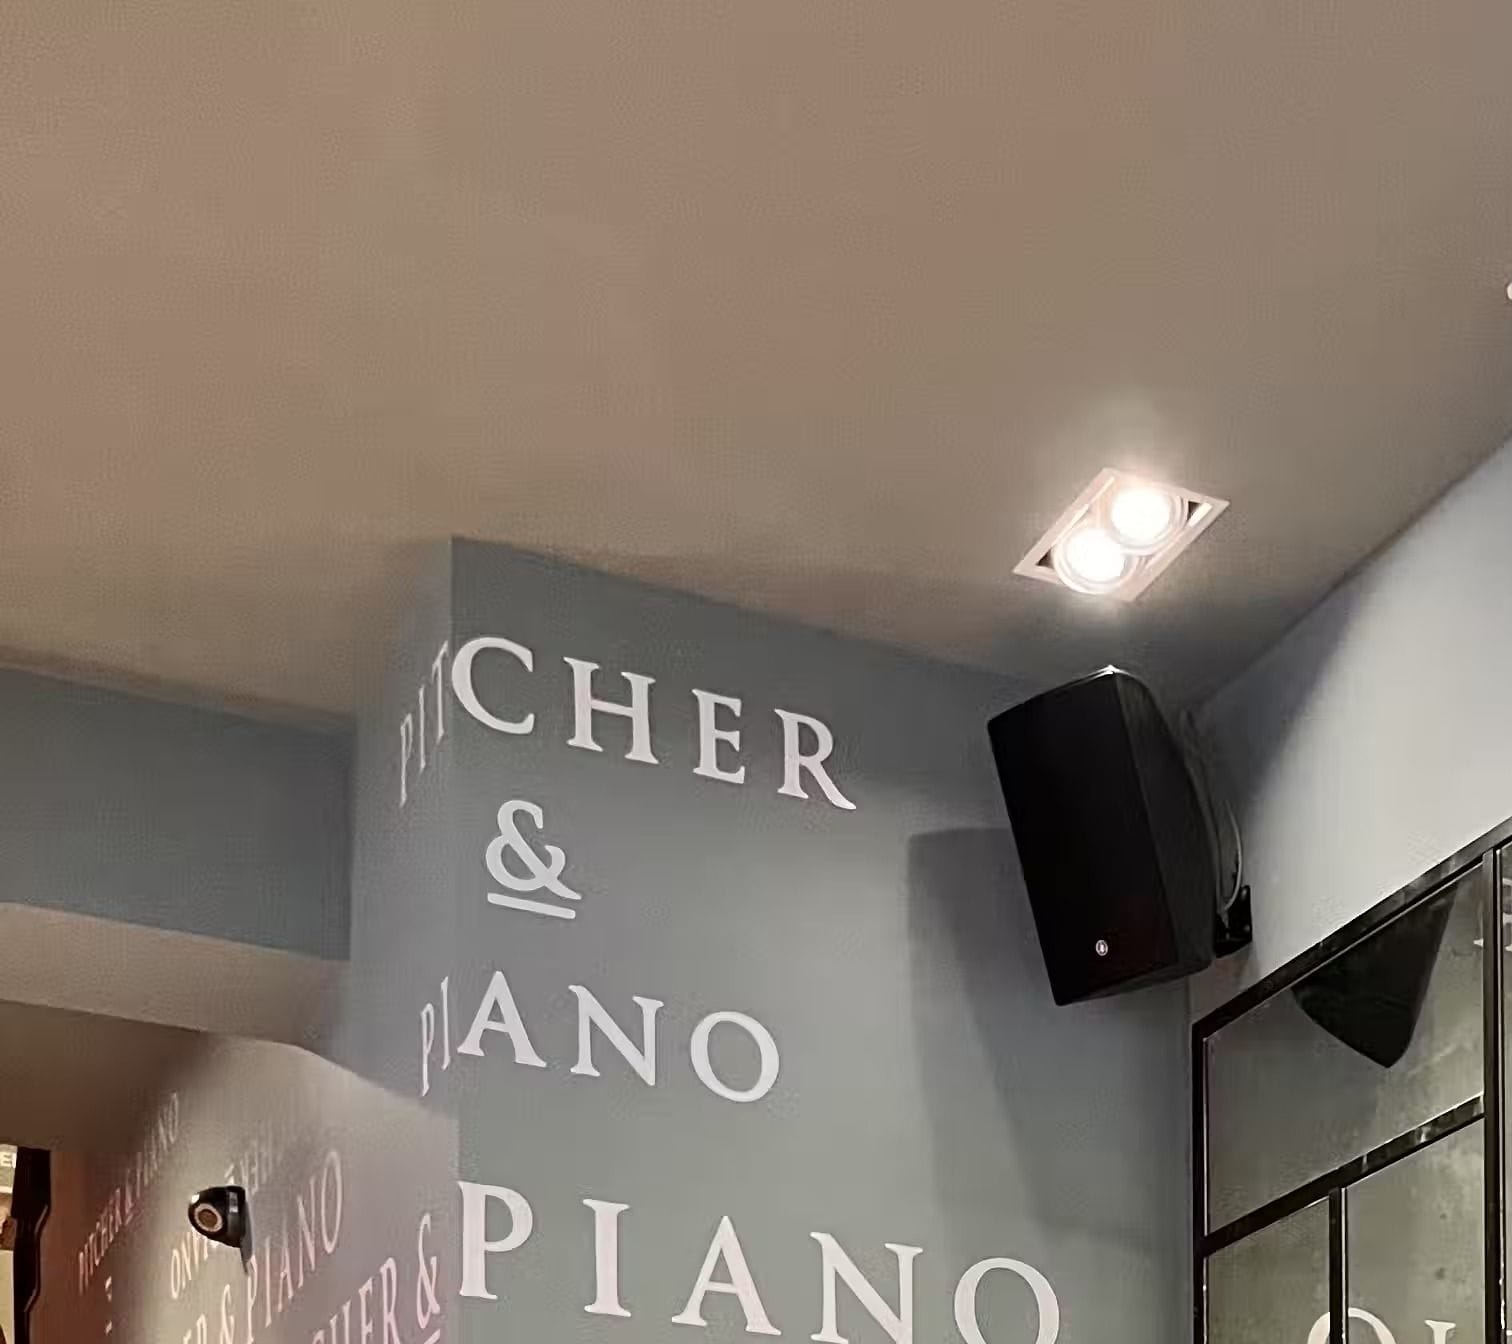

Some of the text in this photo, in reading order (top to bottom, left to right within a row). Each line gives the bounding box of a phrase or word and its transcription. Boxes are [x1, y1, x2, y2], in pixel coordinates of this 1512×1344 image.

[400, 636, 857, 811] PITCHER
[485, 799, 581, 919] &
[420, 971, 781, 1103] PIANO
